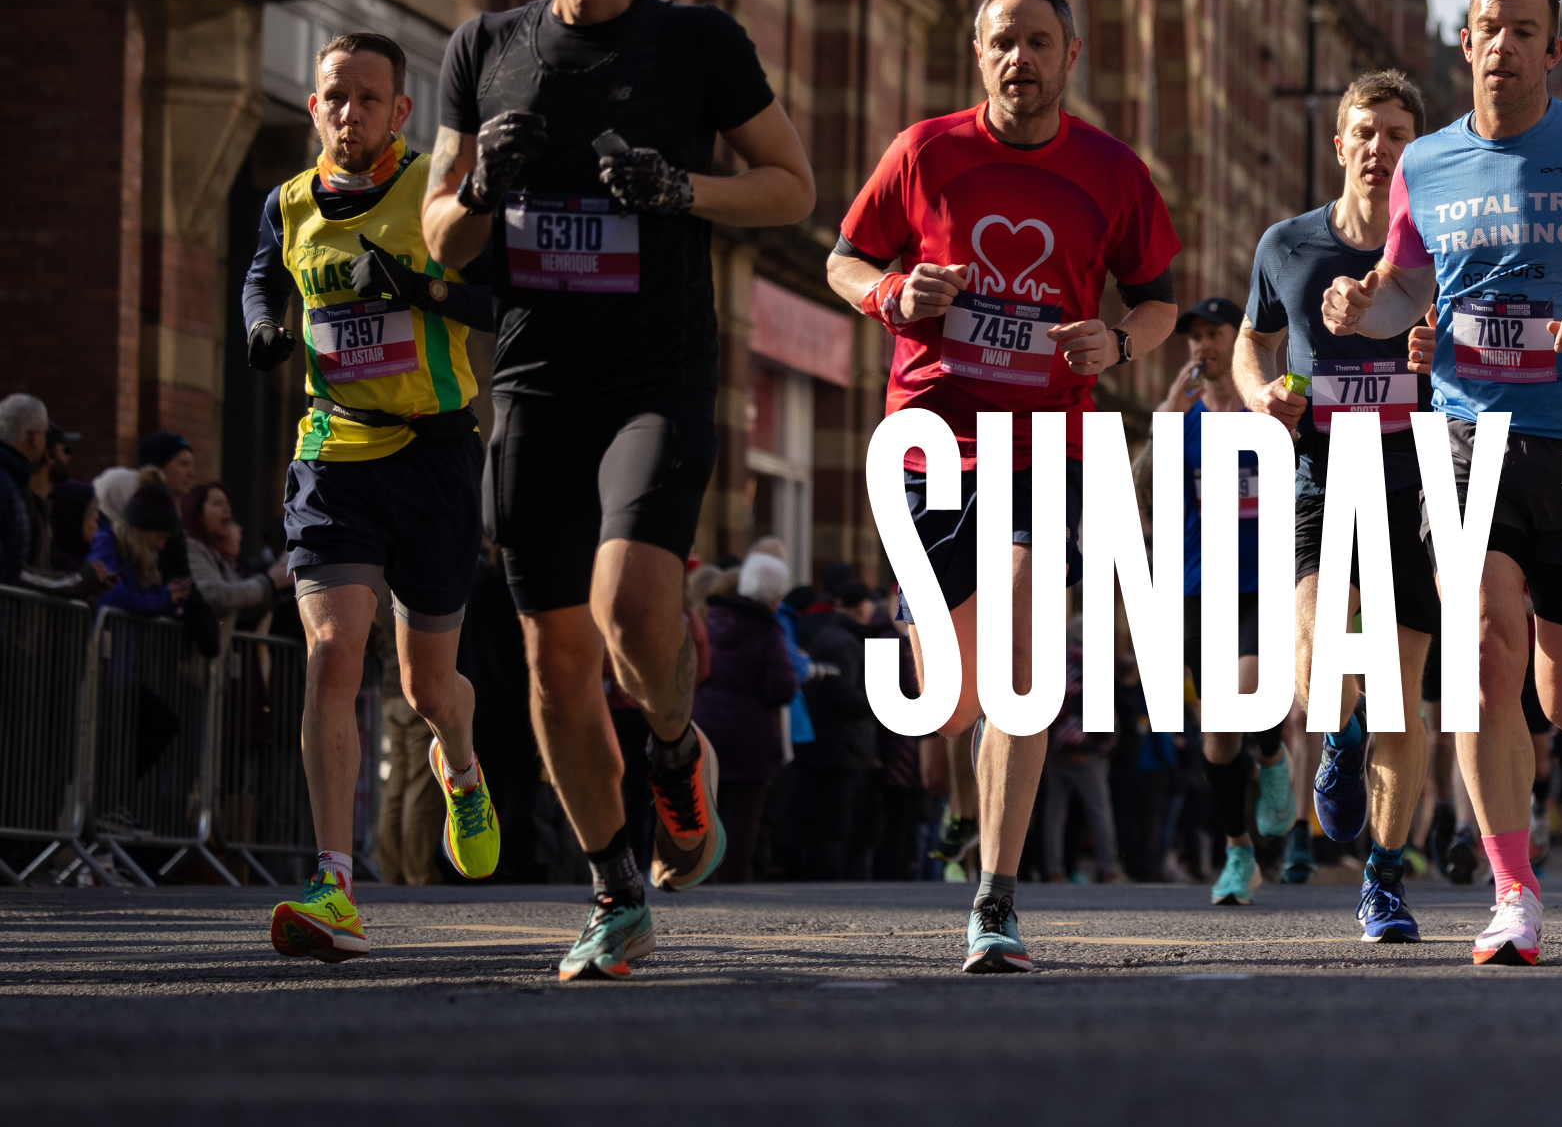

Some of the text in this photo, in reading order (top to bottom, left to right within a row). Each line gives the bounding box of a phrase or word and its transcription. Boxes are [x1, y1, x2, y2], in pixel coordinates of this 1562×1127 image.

[1435, 194, 1518, 223] TOTAL
[537, 215, 602, 251] 6310
[541, 253, 599, 274] HENRIQUE
[327, 308, 352, 318] Therme
[973, 299, 1001, 311] Therme
[1015, 310, 1039, 319] MARATHON
[1016, 304, 1041, 313] MANCHESTER
[1470, 303, 1494, 312] Therme
[331, 316, 385, 350] 7397
[969, 313, 1033, 351] 7456
[1475, 317, 1524, 348] 7012
[341, 347, 385, 367] ALASTAIR
[981, 348, 1011, 367] IWAN
[1479, 349, 1522, 367] WRIGHTY
[1338, 376, 1391, 404] 7707
